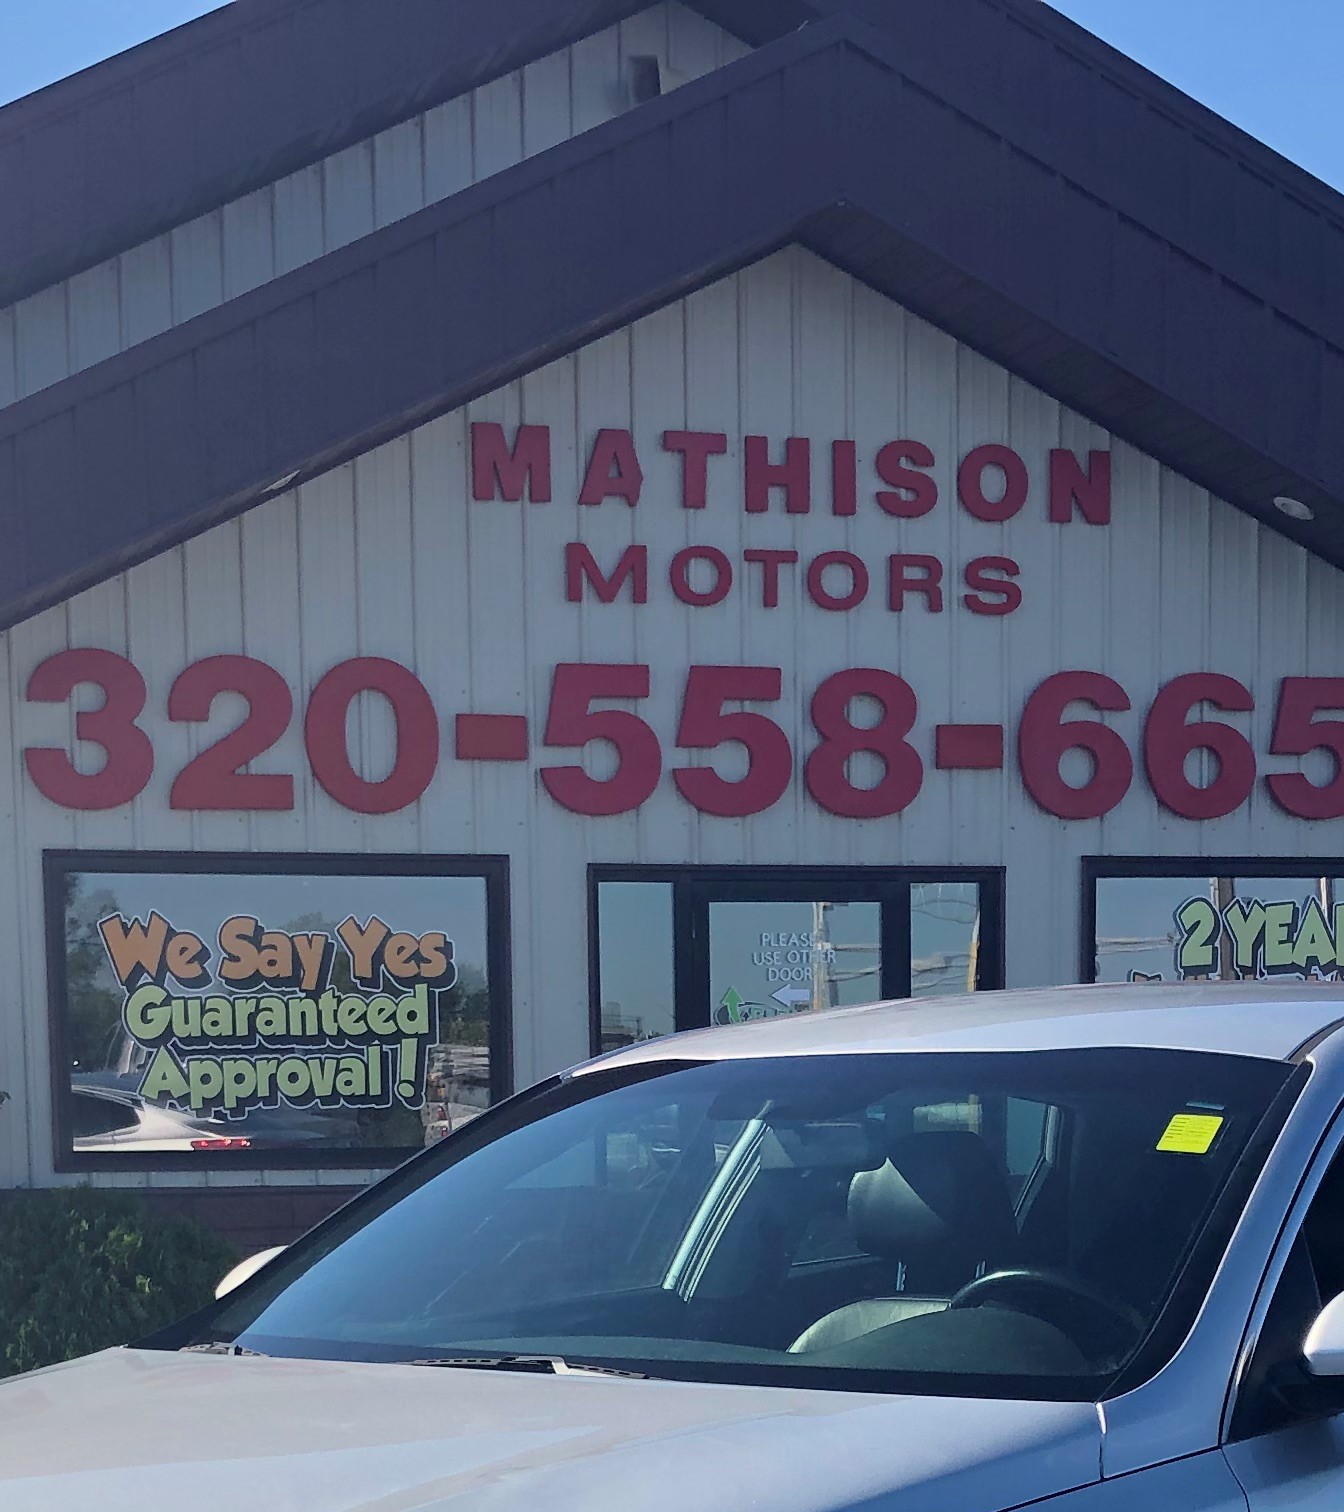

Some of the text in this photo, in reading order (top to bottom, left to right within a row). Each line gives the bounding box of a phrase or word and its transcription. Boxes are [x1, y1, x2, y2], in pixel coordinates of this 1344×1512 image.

[471, 421, 1112, 526] MATHISON
[565, 542, 1023, 616] MOTORS
[98, 910, 452, 990] We Say Yes
[752, 951, 782, 966] USE
[760, 932, 816, 947] PLEASE
[1178, 896, 1218, 969] 2
[768, 967, 813, 981] DOOR
[126, 983, 430, 1041] Guaranteed
